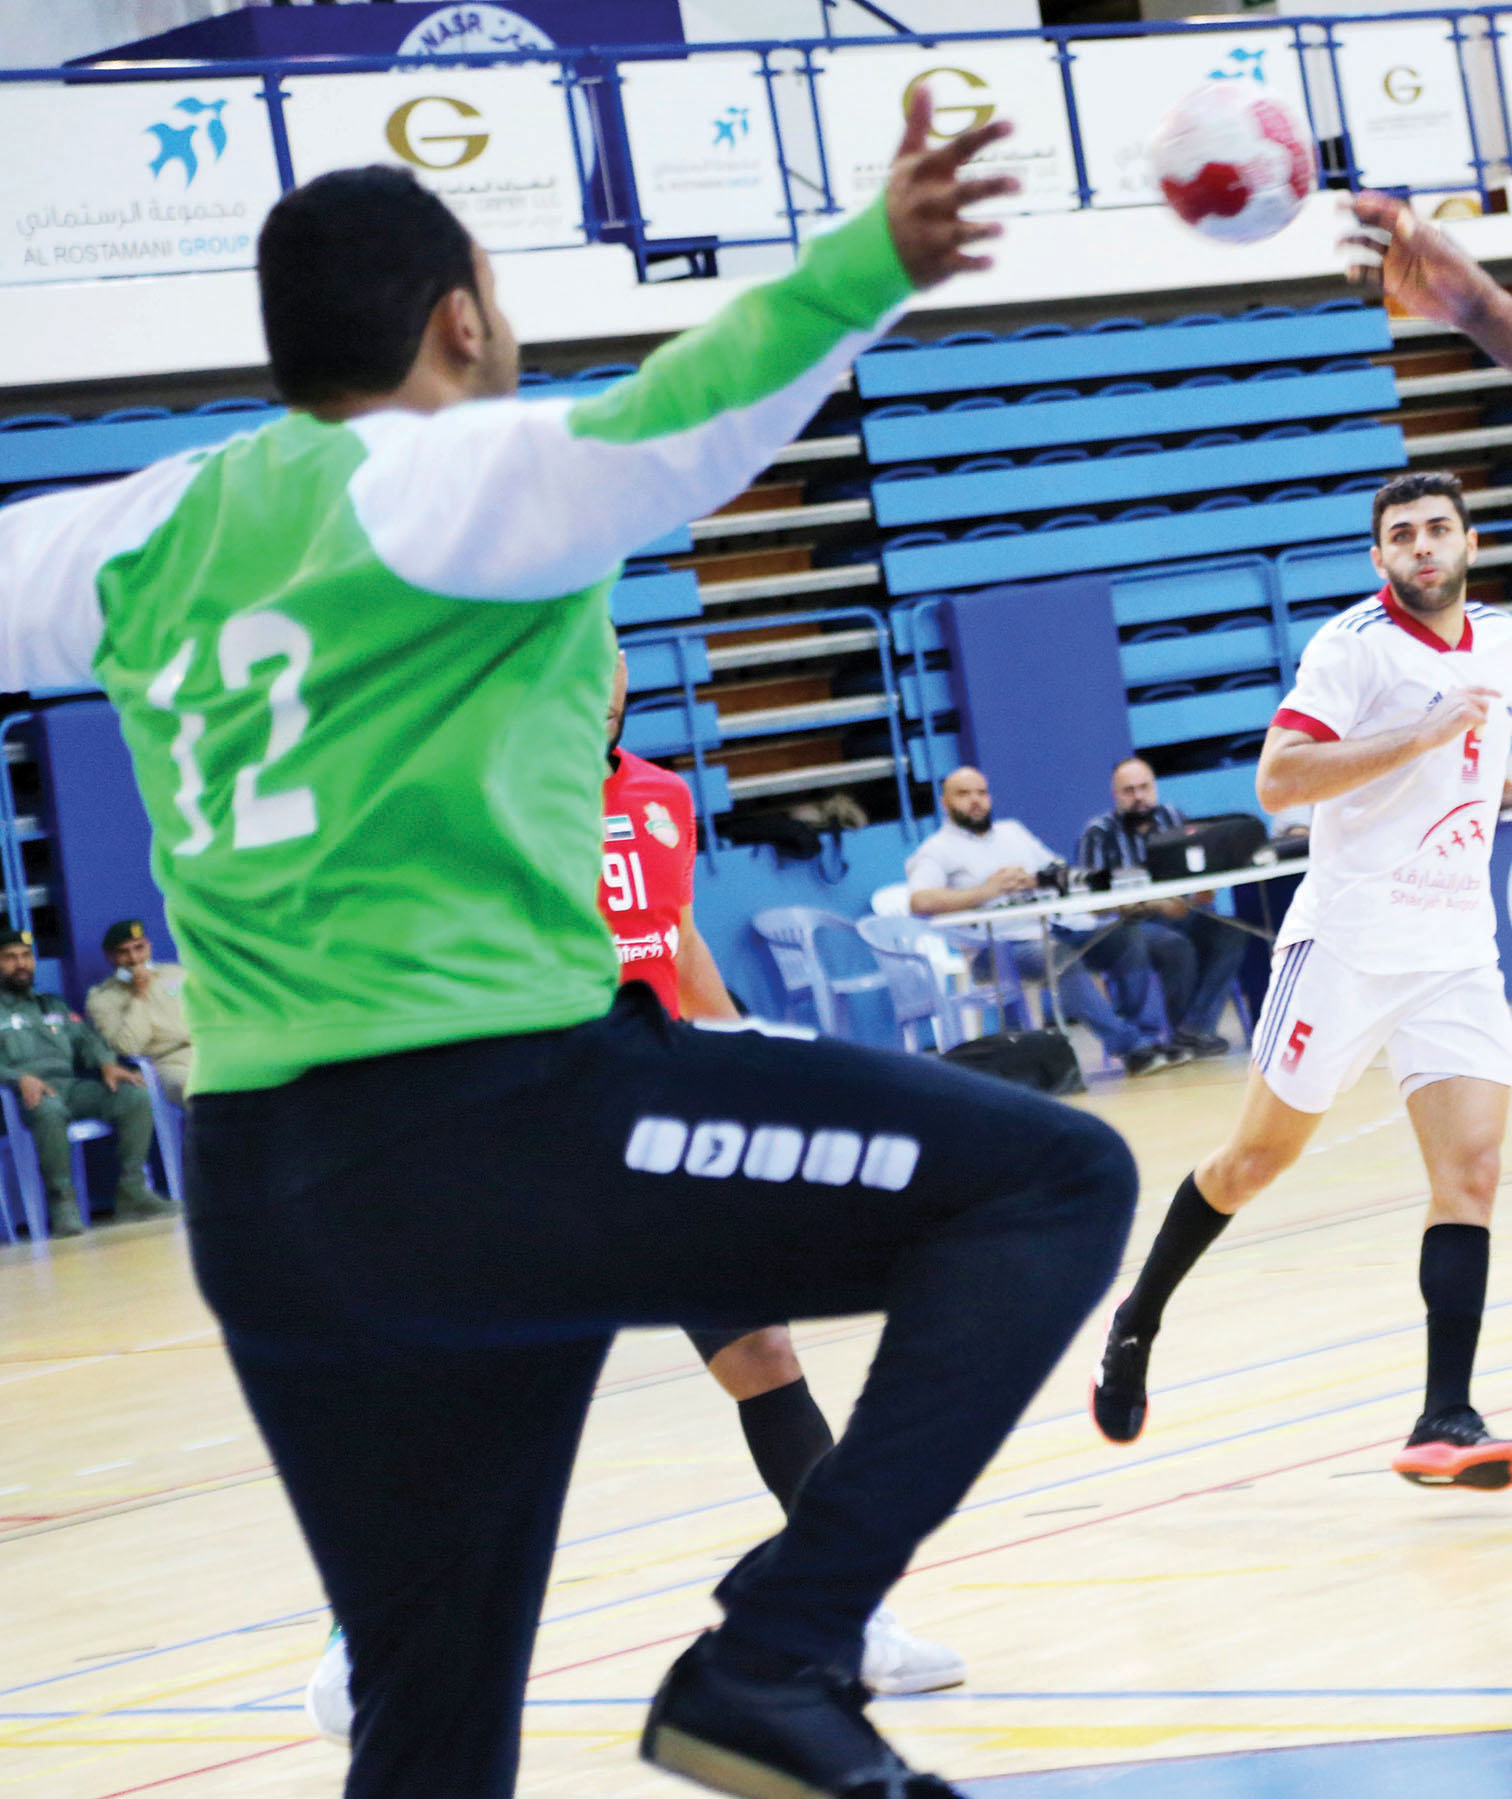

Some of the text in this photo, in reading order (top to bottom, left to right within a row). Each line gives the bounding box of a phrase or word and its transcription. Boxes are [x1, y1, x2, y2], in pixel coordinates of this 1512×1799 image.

[1383, 66, 1424, 103] G
[386, 96, 490, 170] G
[149, 199, 247, 224] مجموعة
[23, 234, 250, 266] AL ROSTAMANI GROUP
[147, 609, 319, 857] 12
[1462, 728, 1482, 783] 5
[603, 851, 648, 911] 91
[1280, 1019, 1313, 1076] 5
